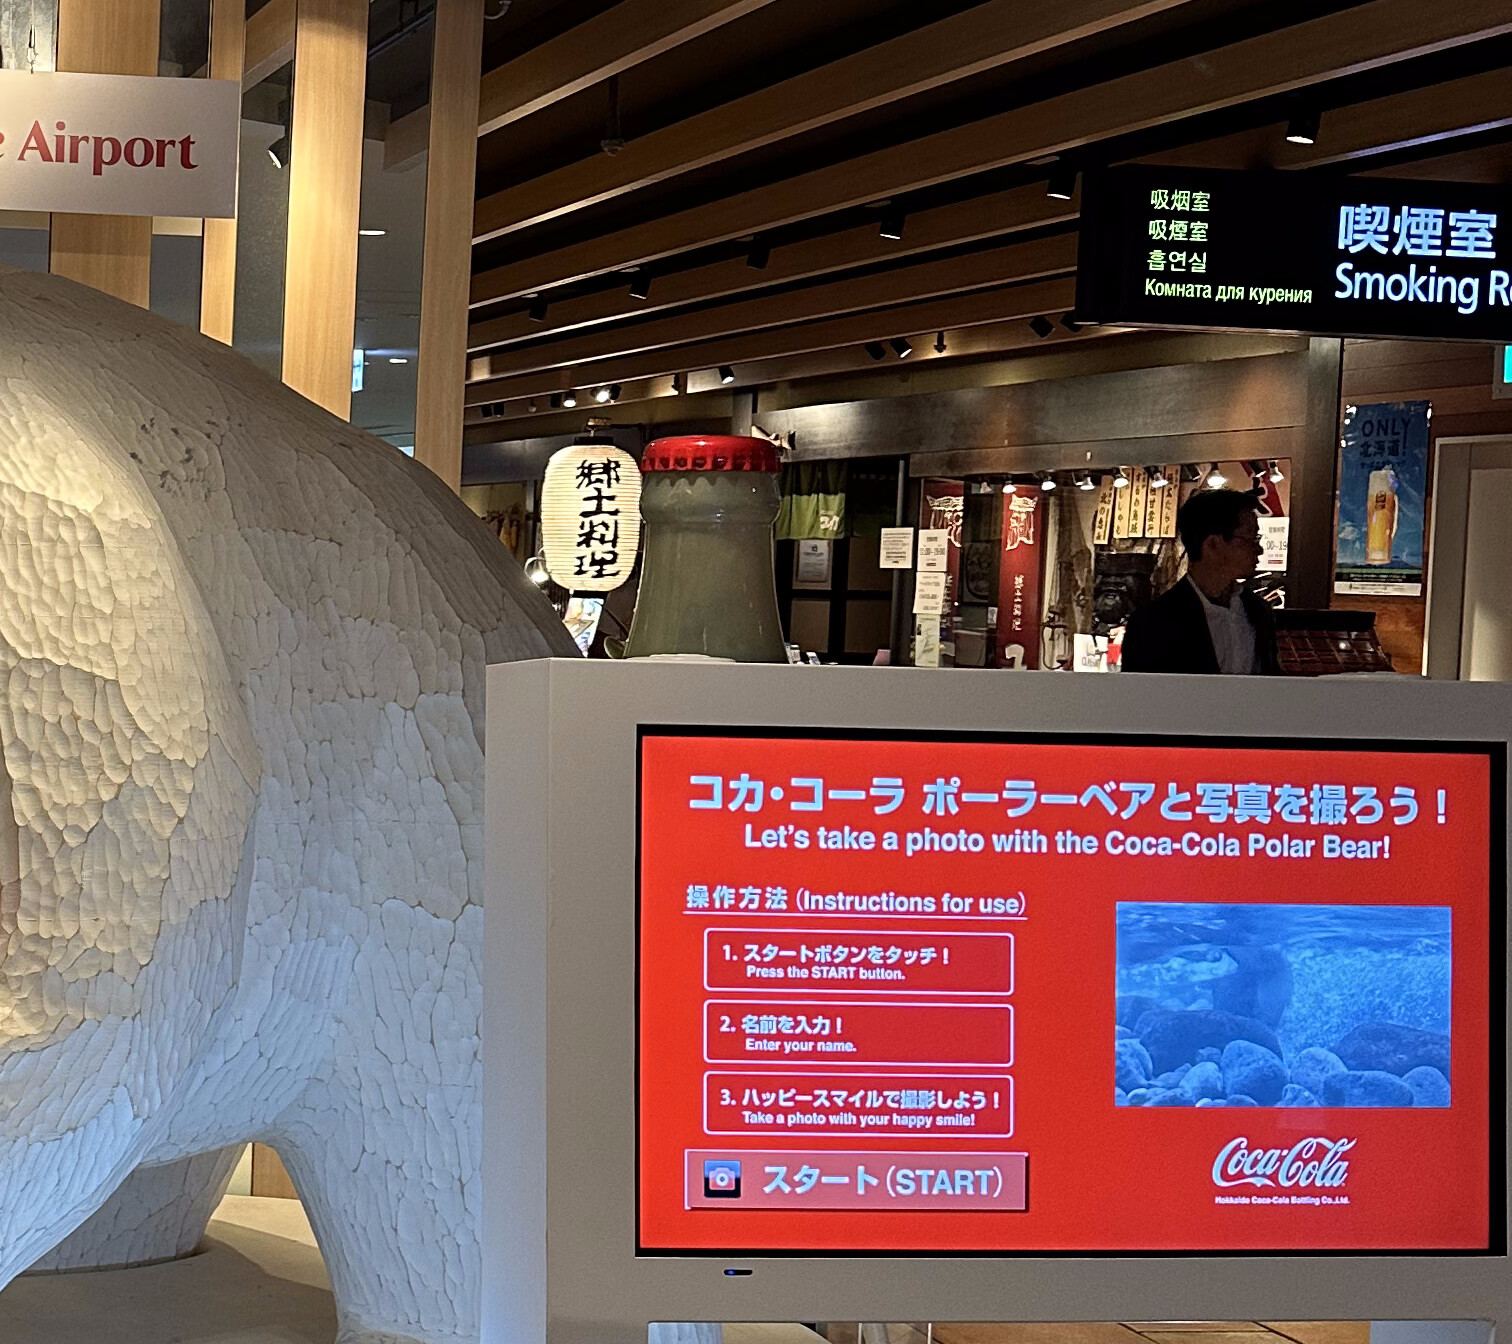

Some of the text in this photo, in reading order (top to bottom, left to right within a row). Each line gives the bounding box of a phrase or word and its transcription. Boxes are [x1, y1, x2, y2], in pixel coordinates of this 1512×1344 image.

[17, 119, 200, 177] Airport
[1150, 188, 1211, 212] 吸烟室
[1148, 219, 1209, 242] 吸煙室
[1337, 203, 1497, 259] 喫煙室
[1146, 249, 1208, 273] 흡연실
[1144, 277, 1313, 306] Комната для курения
[1334, 261, 1480, 315] Smoking
[573, 458, 621, 579] 郷土料理
[689, 772, 905, 816] コカ・コーラ
[744, 823, 1391, 860] Let's take a photo with the Coca-Cola Polar Bear!
[685, 884, 1026, 916] 操作方法 (Instructions for use)
[746, 965, 906, 981] Press the START button.
[745, 1038, 858, 1055] Enter your name.
[741, 1111, 976, 1129] Take a photo with your happy smile!
[1212, 1137, 1358, 1188] Coca-Cola
